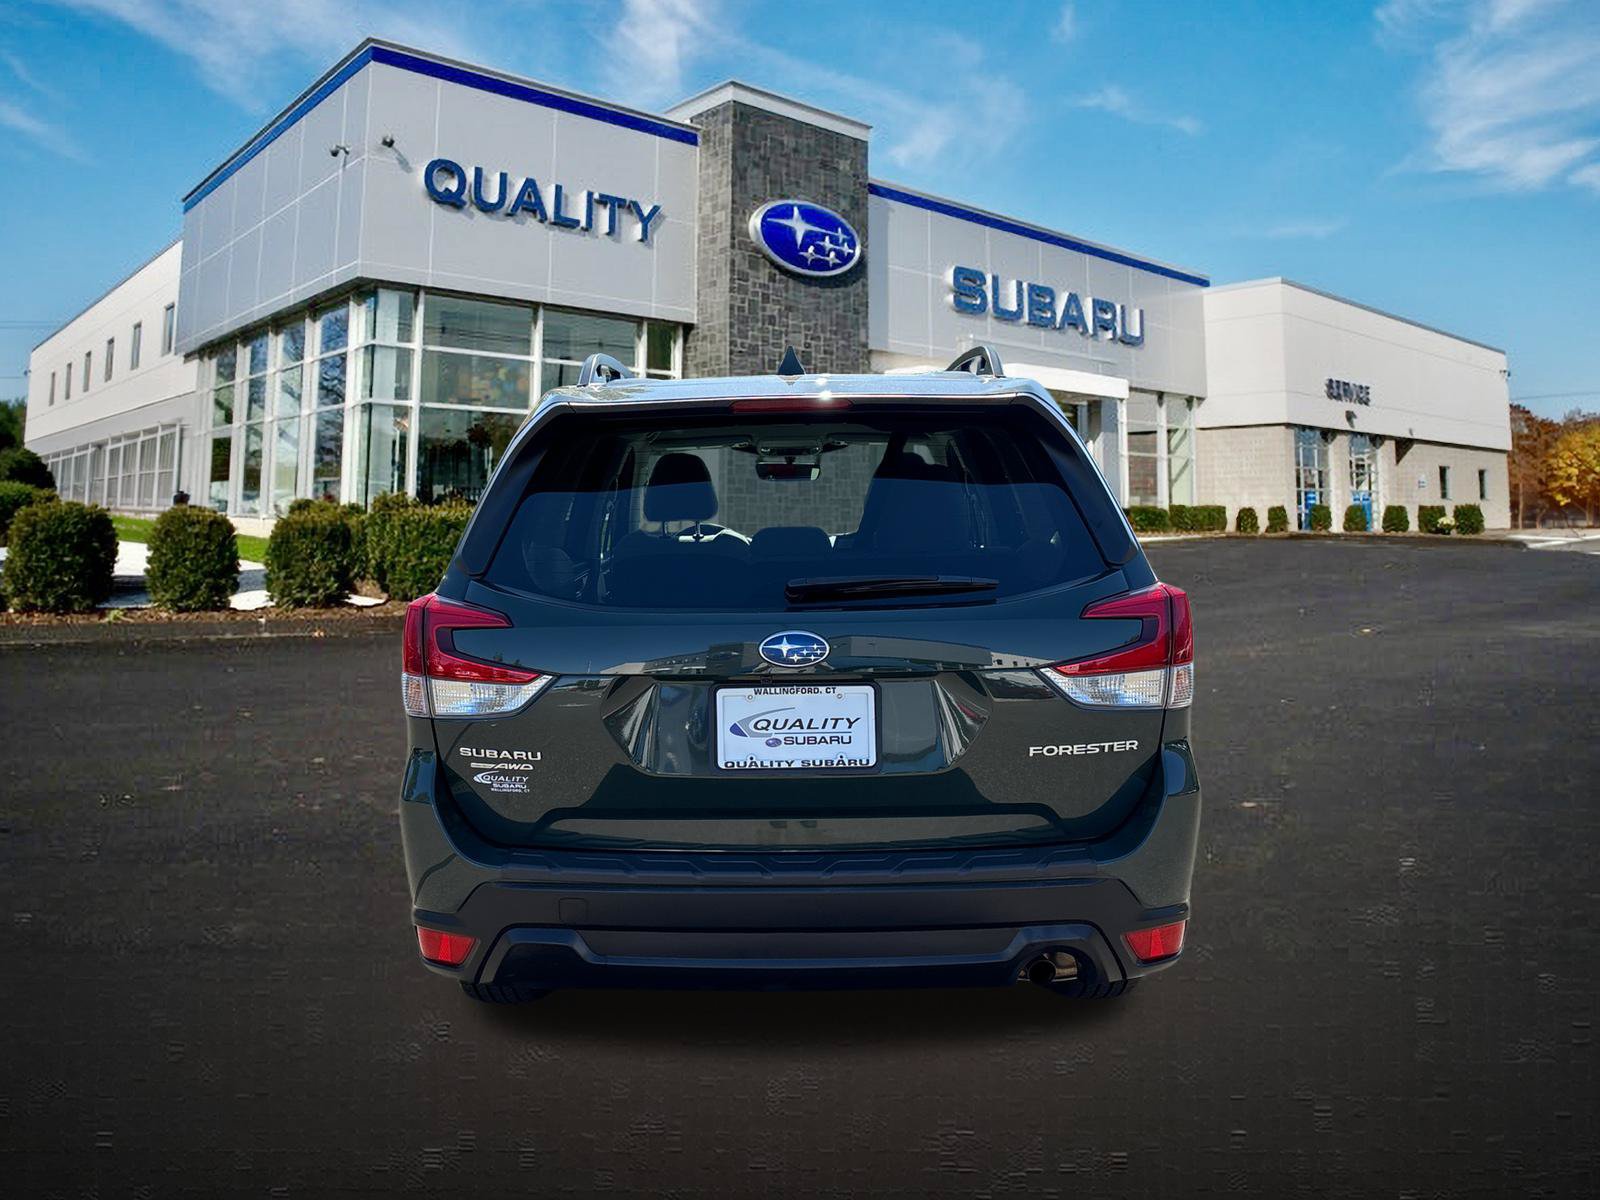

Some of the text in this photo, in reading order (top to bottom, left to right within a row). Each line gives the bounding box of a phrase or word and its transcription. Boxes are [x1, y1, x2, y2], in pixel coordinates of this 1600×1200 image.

[424, 158, 661, 242] QUALITY
[951, 265, 1145, 346] SUBARU
[753, 717, 861, 731] QUALITY
[783, 736, 852, 746] SUBARU
[459, 747, 542, 761] SUBARU
[1029, 740, 1139, 757] FORESTER
[494, 763, 534, 771] AWD
[724, 759, 870, 768] QUALITY SUBARU
[483, 774, 529, 782] QUALITY
